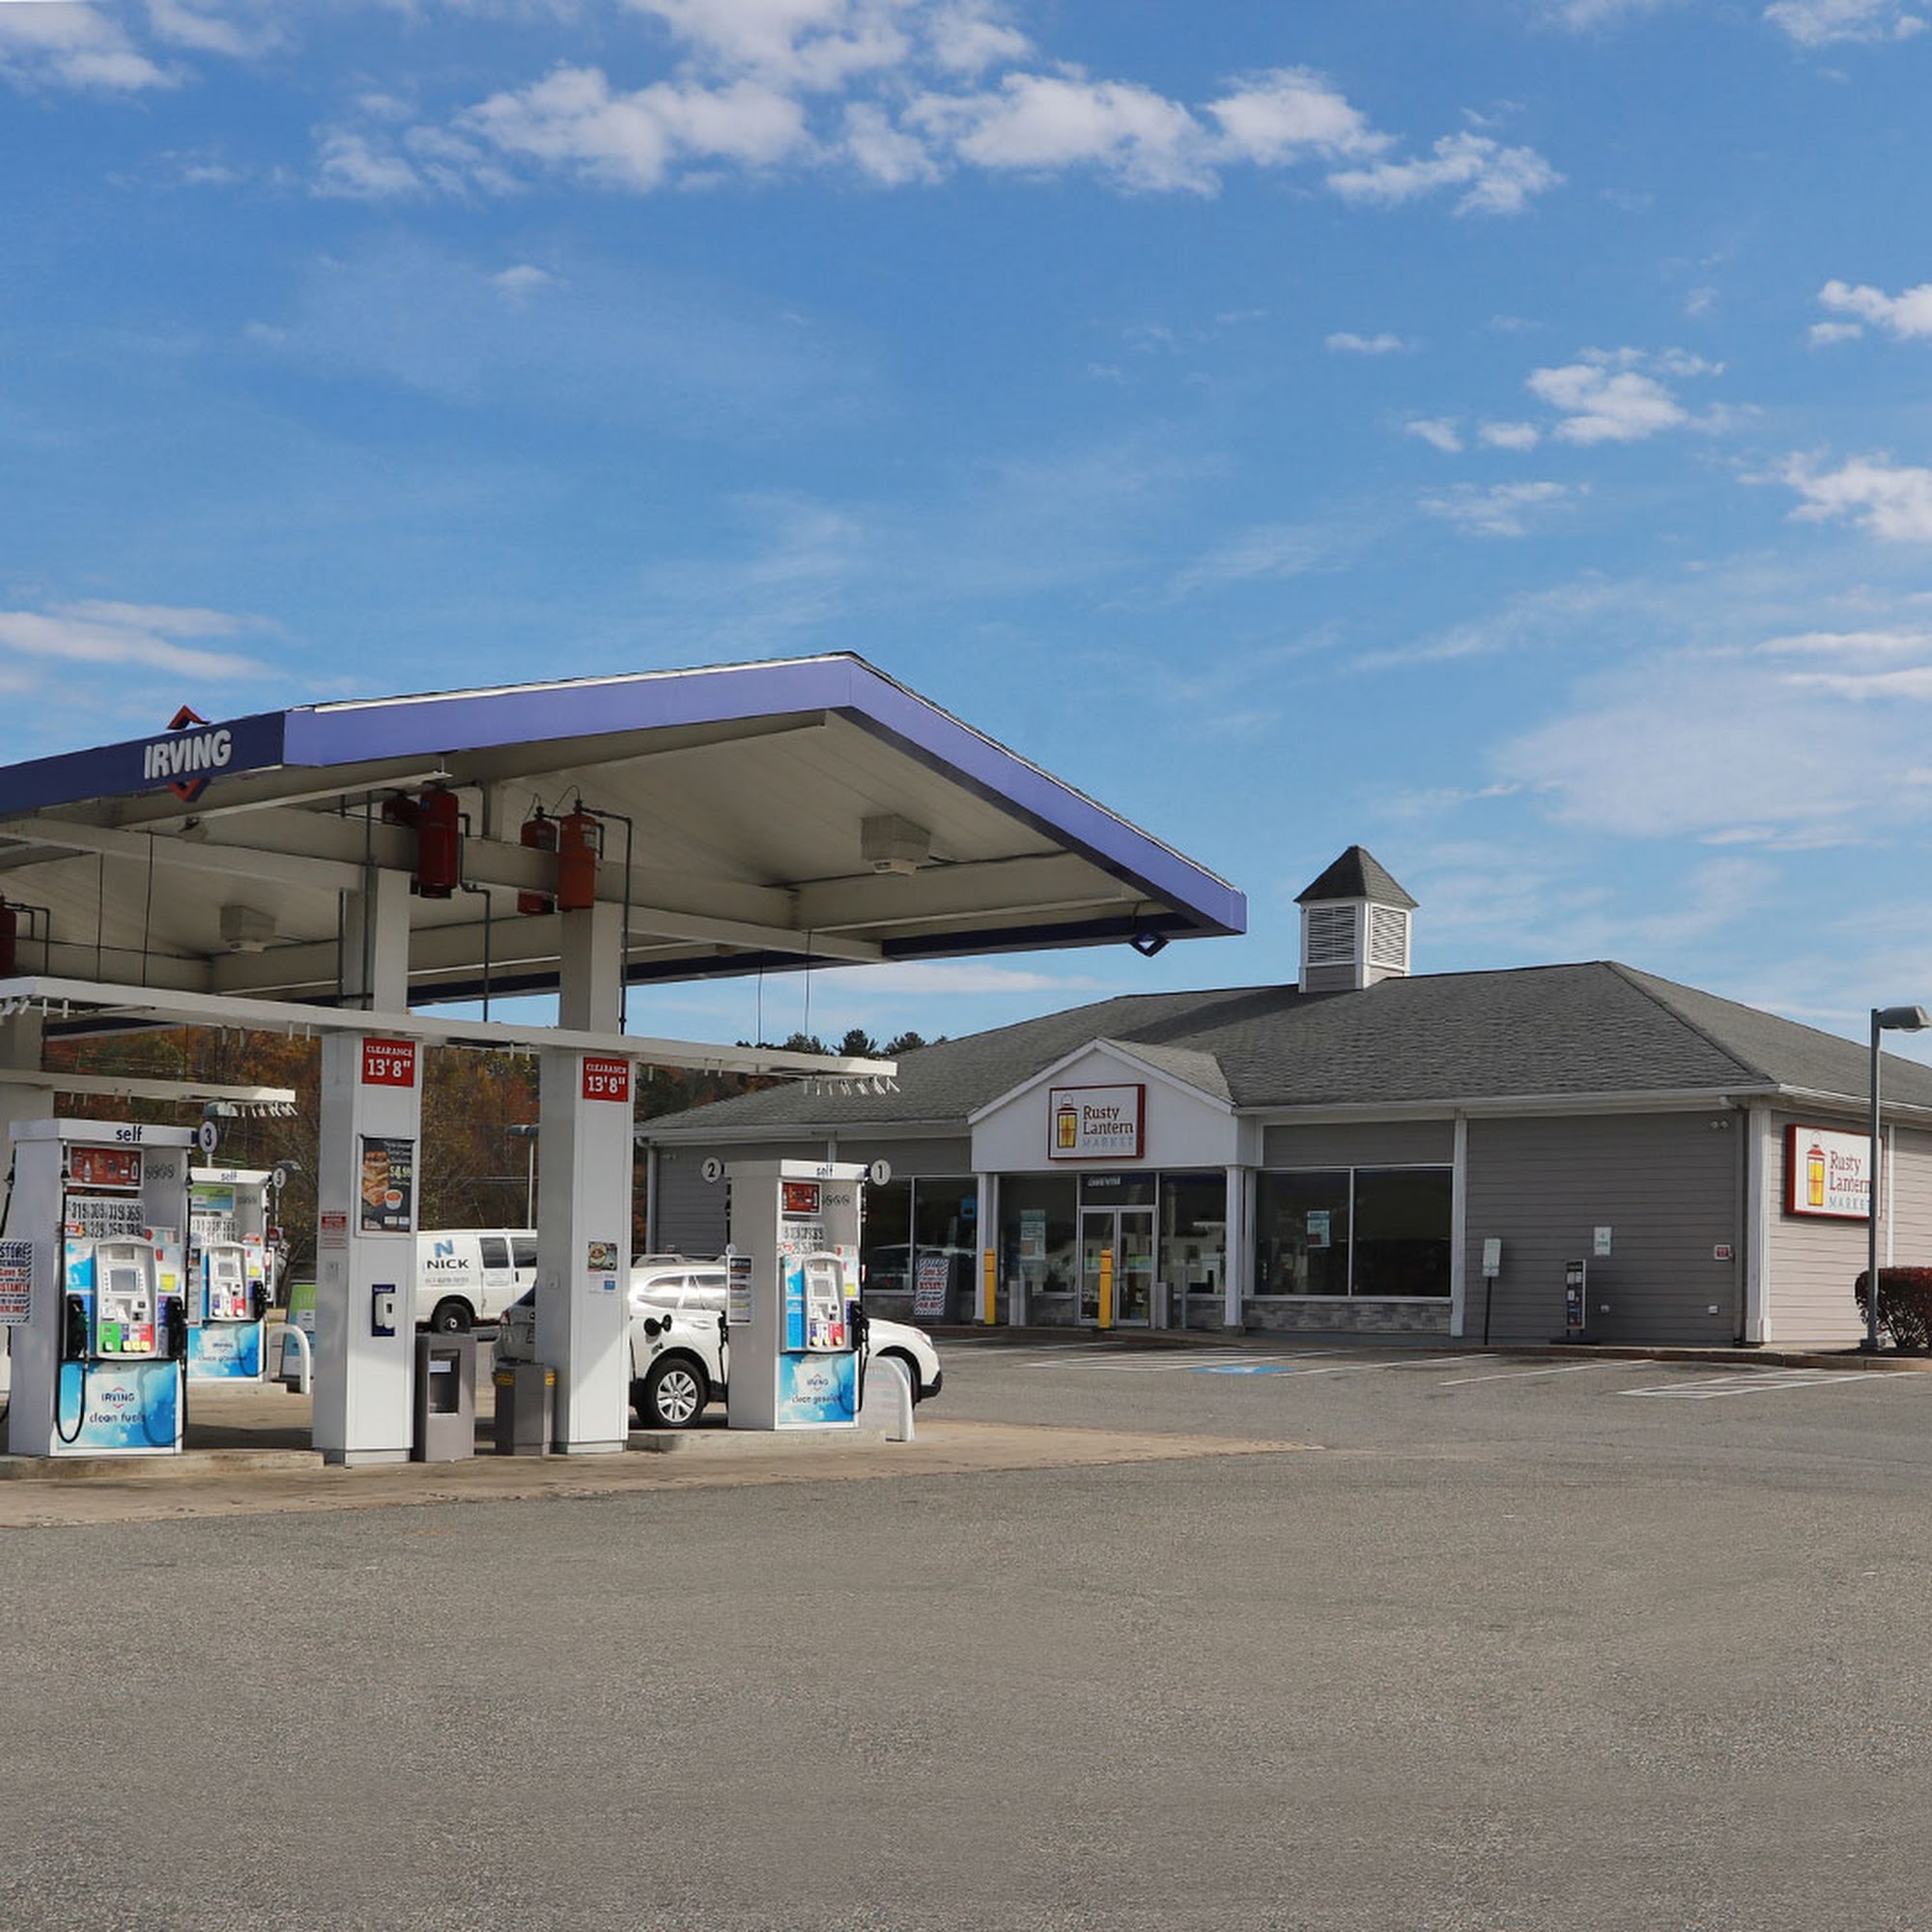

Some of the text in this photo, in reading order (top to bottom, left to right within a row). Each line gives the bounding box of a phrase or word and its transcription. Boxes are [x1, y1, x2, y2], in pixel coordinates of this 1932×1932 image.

[144, 728, 232, 780] IRVING
[367, 1045, 412, 1058] CLEARANCE
[586, 1064, 626, 1074] CLEARANCE
[1083, 1105, 1120, 1121] Rusty
[116, 1124, 143, 1142] self
[1083, 1121, 1134, 1135] Lantern
[204, 1127, 213, 1148] 3
[1082, 1137, 1135, 1147] MARKET
[707, 1161, 715, 1178] 2
[1830, 1150, 1861, 1176] Rusty
[877, 1164, 884, 1179] 1
[1829, 1196, 1870, 1209] MARKE
[427, 1259, 469, 1269] NICK
[101, 1393, 135, 1402] IRVING
